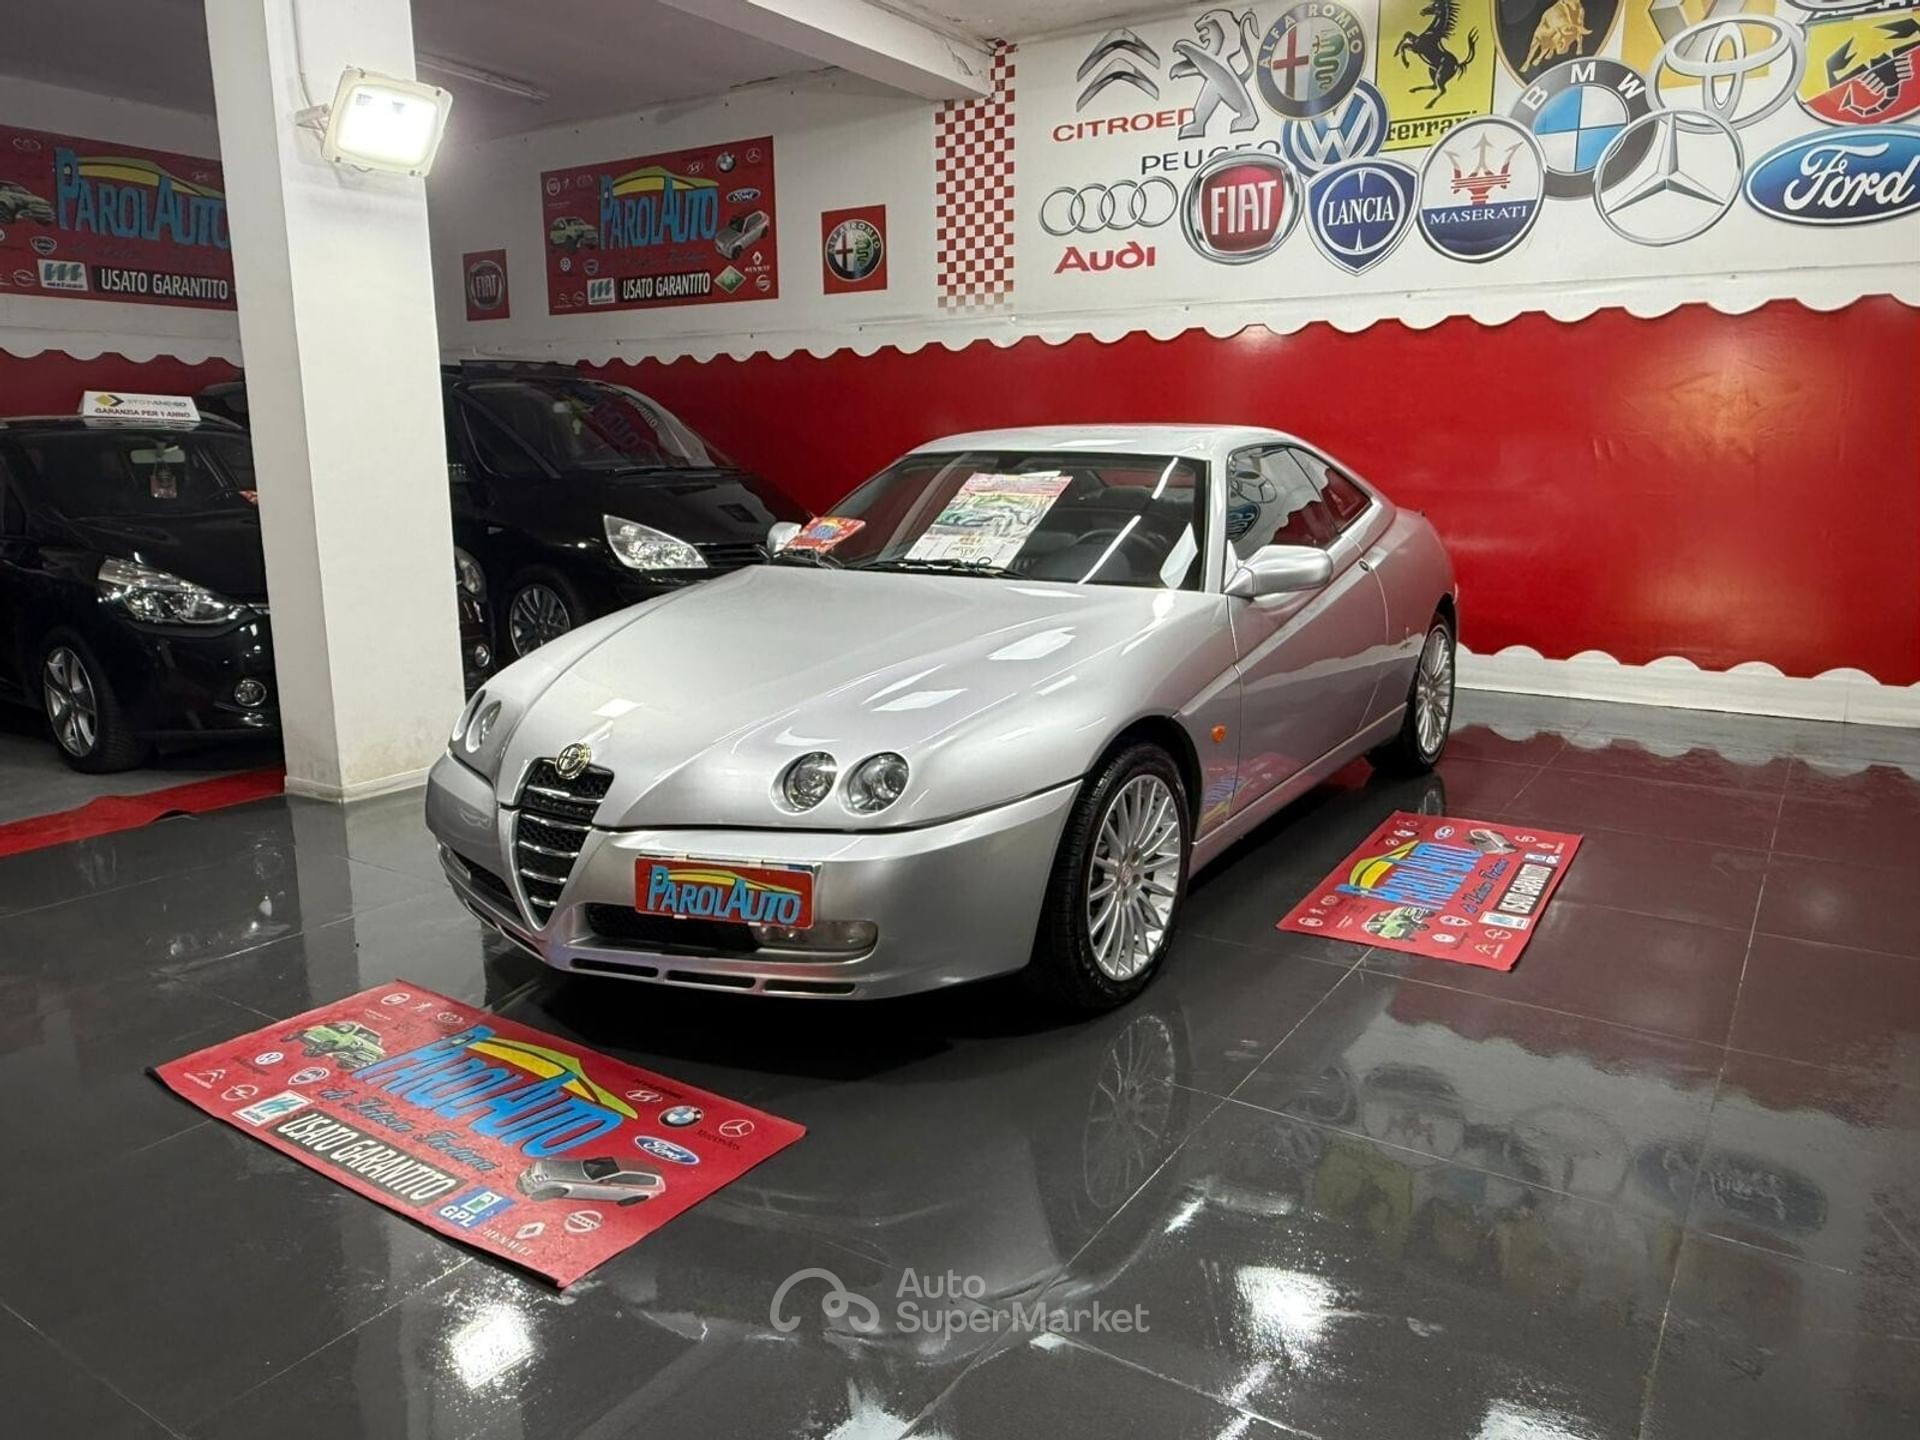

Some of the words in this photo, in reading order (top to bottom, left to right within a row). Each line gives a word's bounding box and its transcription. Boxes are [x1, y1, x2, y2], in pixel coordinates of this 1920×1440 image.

[1259, 15, 1297, 68] ALFA
[1307, 3, 1363, 55] ROMEO
[1524, 61, 1646, 109] BMW
[1385, 111, 1477, 141] Ferra
[1783, 142, 1919, 209] Ford
[1210, 180, 1277, 236] FIAT
[1326, 195, 1395, 228] LANCIA
[1430, 205, 1529, 226] MASERATI
[1054, 241, 1156, 274] Audi
[101, 268, 148, 293] USATO
[152, 275, 228, 300] GARANTITO
[623, 276, 653, 299] USATO
[656, 272, 711, 297] GARANTITO
[277, 1113, 359, 1151] USATO
[330, 1140, 457, 1201] GARANTITO
[440, 1205, 477, 1228] GPL
